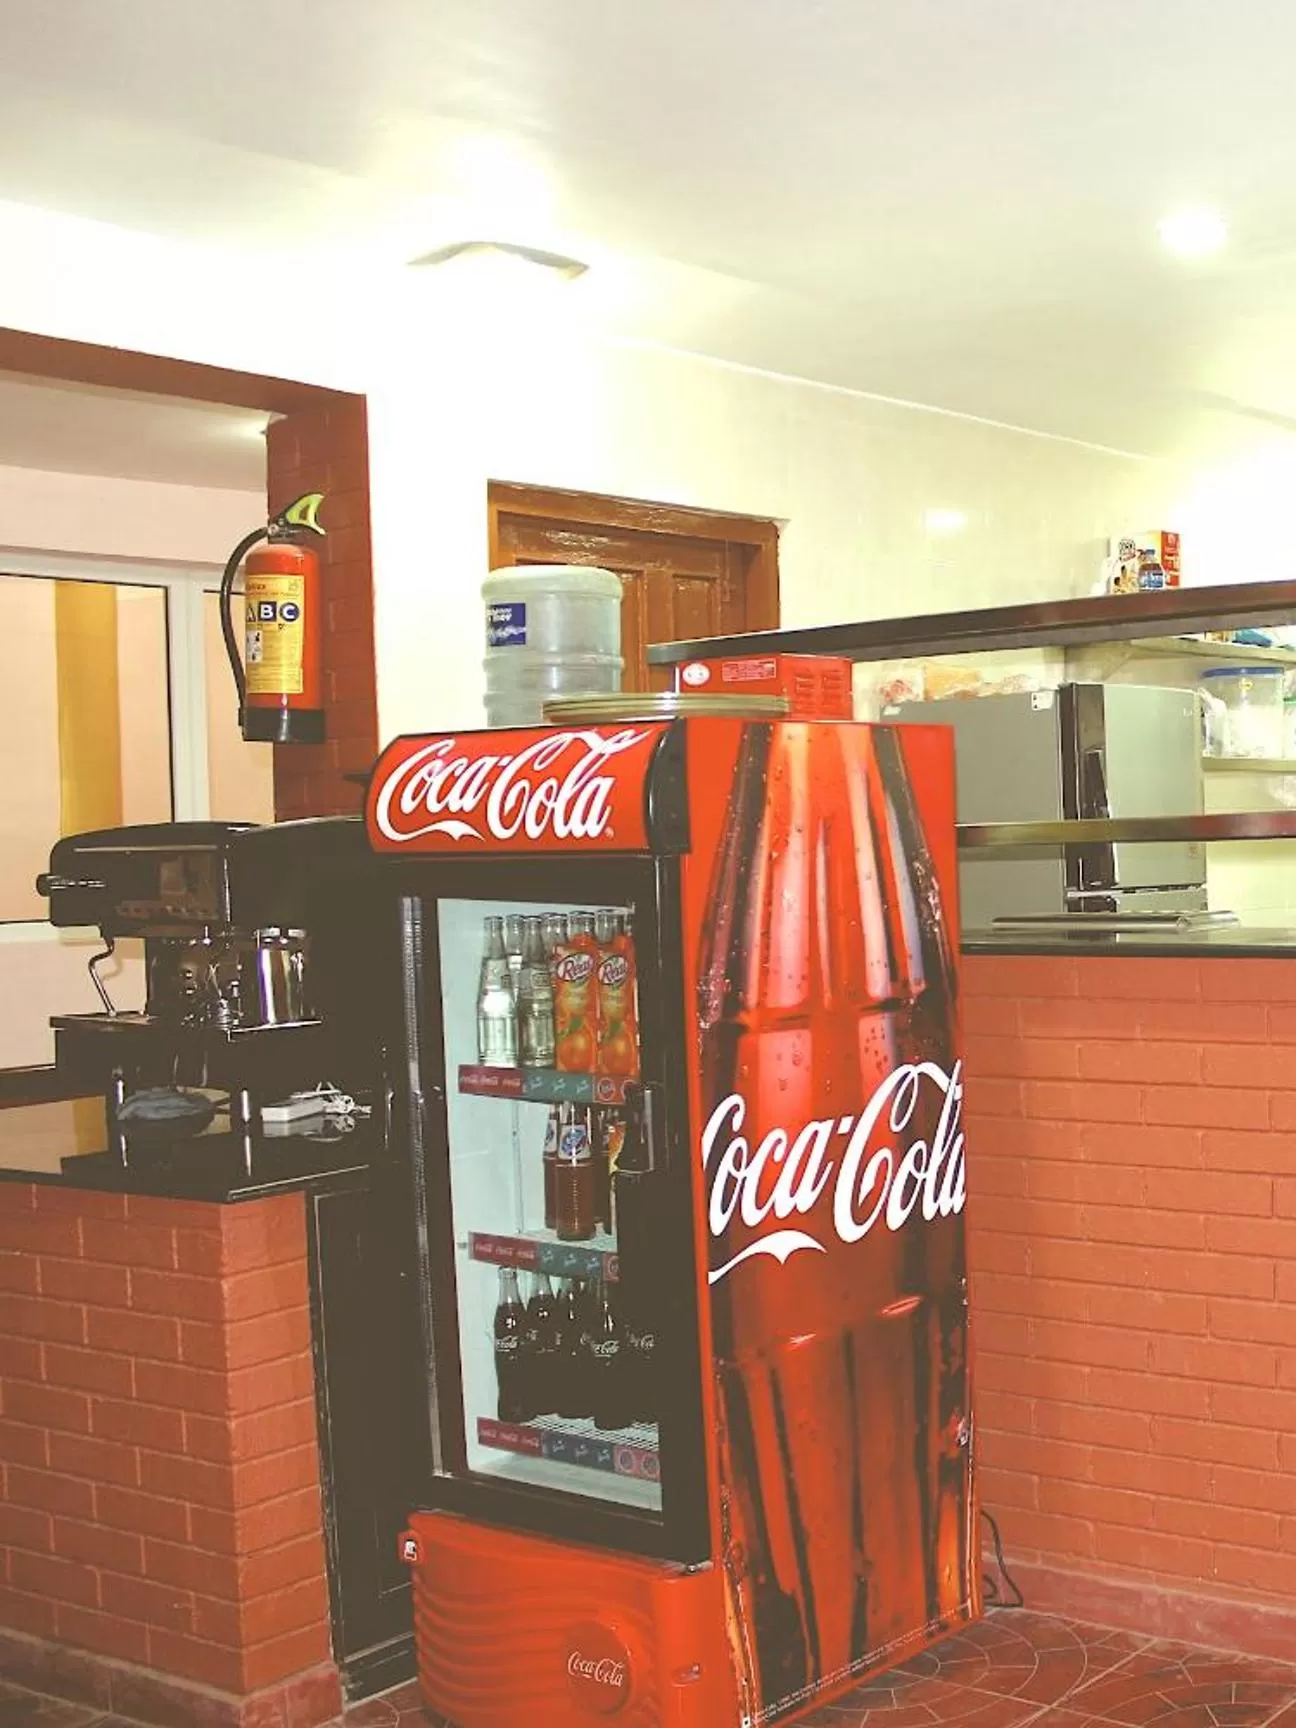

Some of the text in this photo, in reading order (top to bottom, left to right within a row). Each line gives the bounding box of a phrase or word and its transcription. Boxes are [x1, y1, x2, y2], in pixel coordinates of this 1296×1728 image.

[376, 728, 651, 841] Coca-Cola
[701, 1059, 967, 1285] Coca-Cola
[567, 1651, 624, 1688] Coca-Cola
